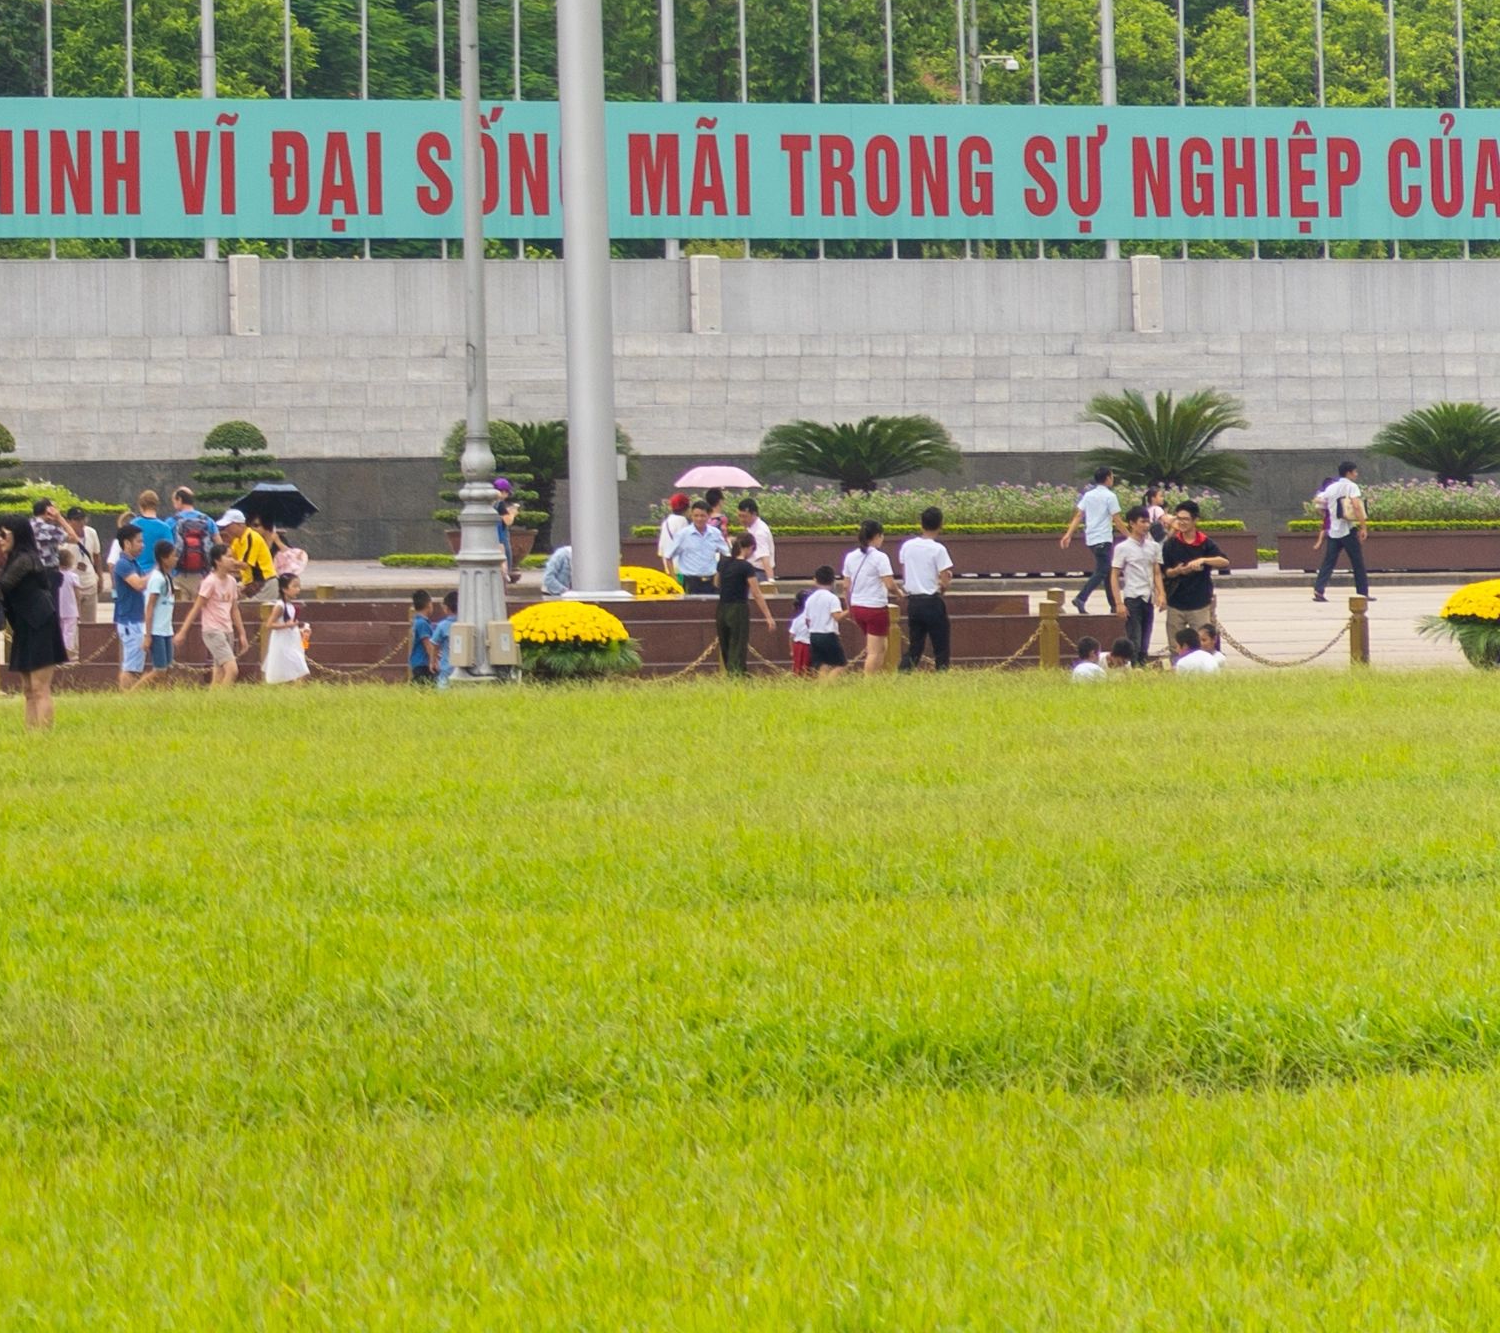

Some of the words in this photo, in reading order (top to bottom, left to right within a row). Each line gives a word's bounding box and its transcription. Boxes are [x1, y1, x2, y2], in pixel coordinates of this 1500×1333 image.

[175, 113, 238, 214] VĨ
[269, 131, 383, 232] ĐẠI
[416, 107, 563, 215] SỐN
[628, 116, 751, 215] MÃI
[780, 135, 992, 217] TRONG
[1024, 124, 1107, 233] SỰ
[1132, 120, 1361, 233] NGHIỆP
[1387, 113, 1500, 218] CỦA
